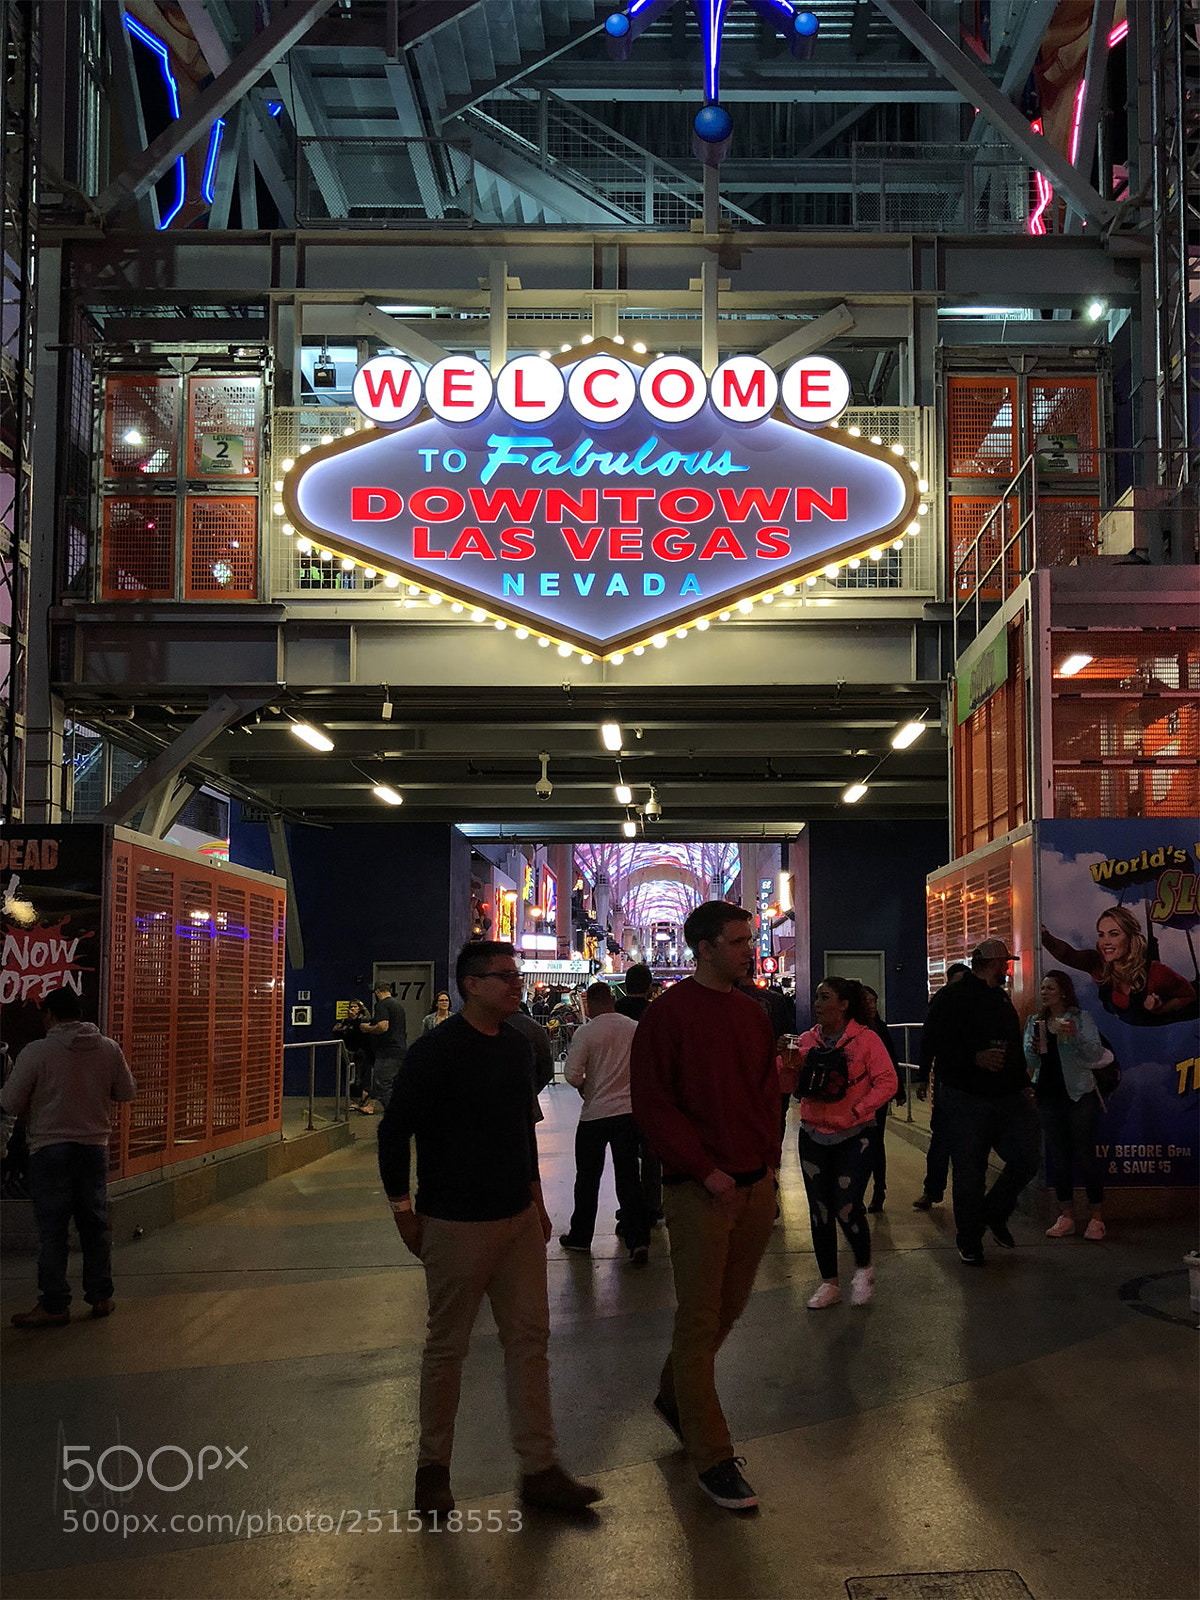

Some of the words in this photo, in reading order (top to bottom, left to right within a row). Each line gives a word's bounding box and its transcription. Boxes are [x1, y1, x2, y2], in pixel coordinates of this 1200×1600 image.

[362, 368, 832, 408] WELCOME
[216, 441, 229, 458] 2
[418, 448, 467, 473] TO
[480, 433, 750, 485] Fabulous
[1052, 441, 1064, 458] 2
[350, 486, 849, 524] DOWNTOWN
[412, 526, 536, 561] LAS
[560, 526, 792, 562] VEGAS
[502, 572, 703, 597] NEVADA
[1089, 845, 1186, 883] World's
[761, 892, 769, 951] PORTAL
[1, 934, 79, 970] NOW
[0, 969, 83, 1004] OPEN
[1108, 1161, 1118, 1174] &
[1123, 1161, 1156, 1174] SAVE
[1115, 1144, 1162, 1158] BEFORE
